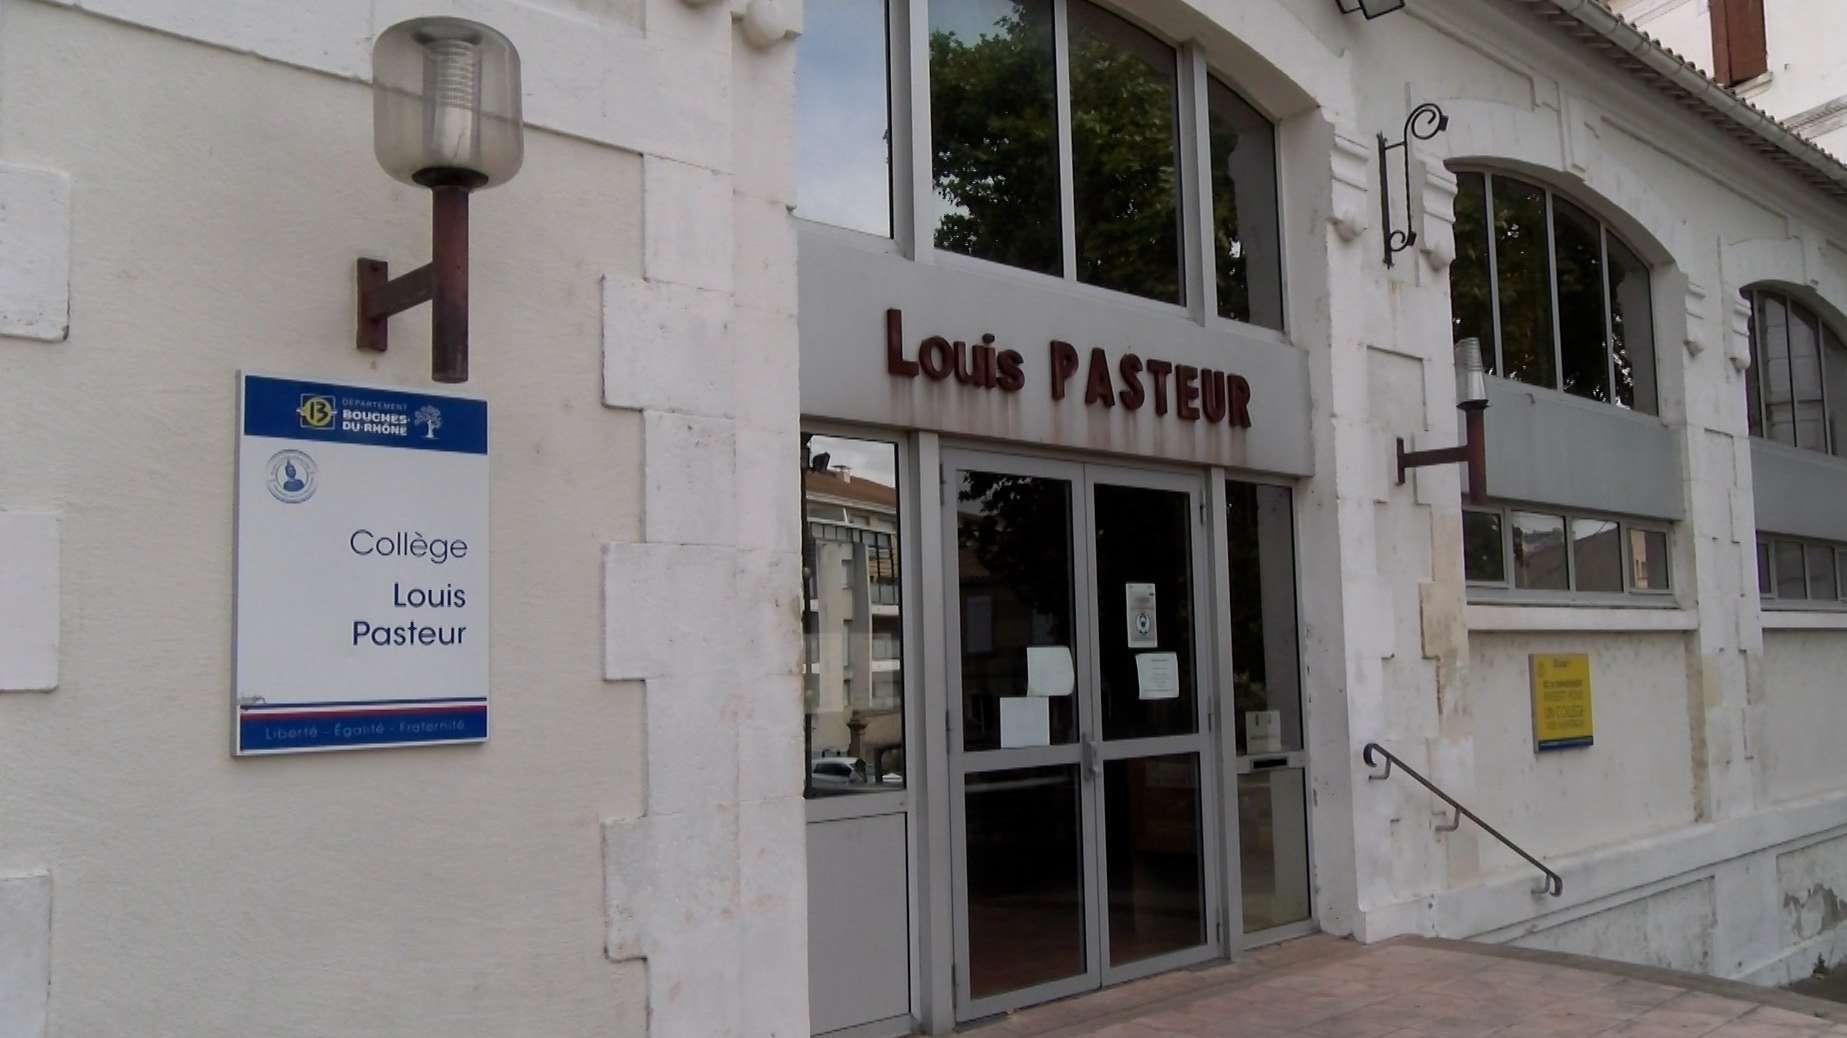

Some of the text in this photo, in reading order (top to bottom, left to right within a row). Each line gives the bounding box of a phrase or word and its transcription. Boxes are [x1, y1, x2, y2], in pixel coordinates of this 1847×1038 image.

[886, 308, 1252, 428] Louis PASTEUR
[309, 401, 329, 424] 13
[350, 529, 468, 564] Collège
[394, 582, 466, 608] Louis
[352, 620, 466, 646] Pasteur
